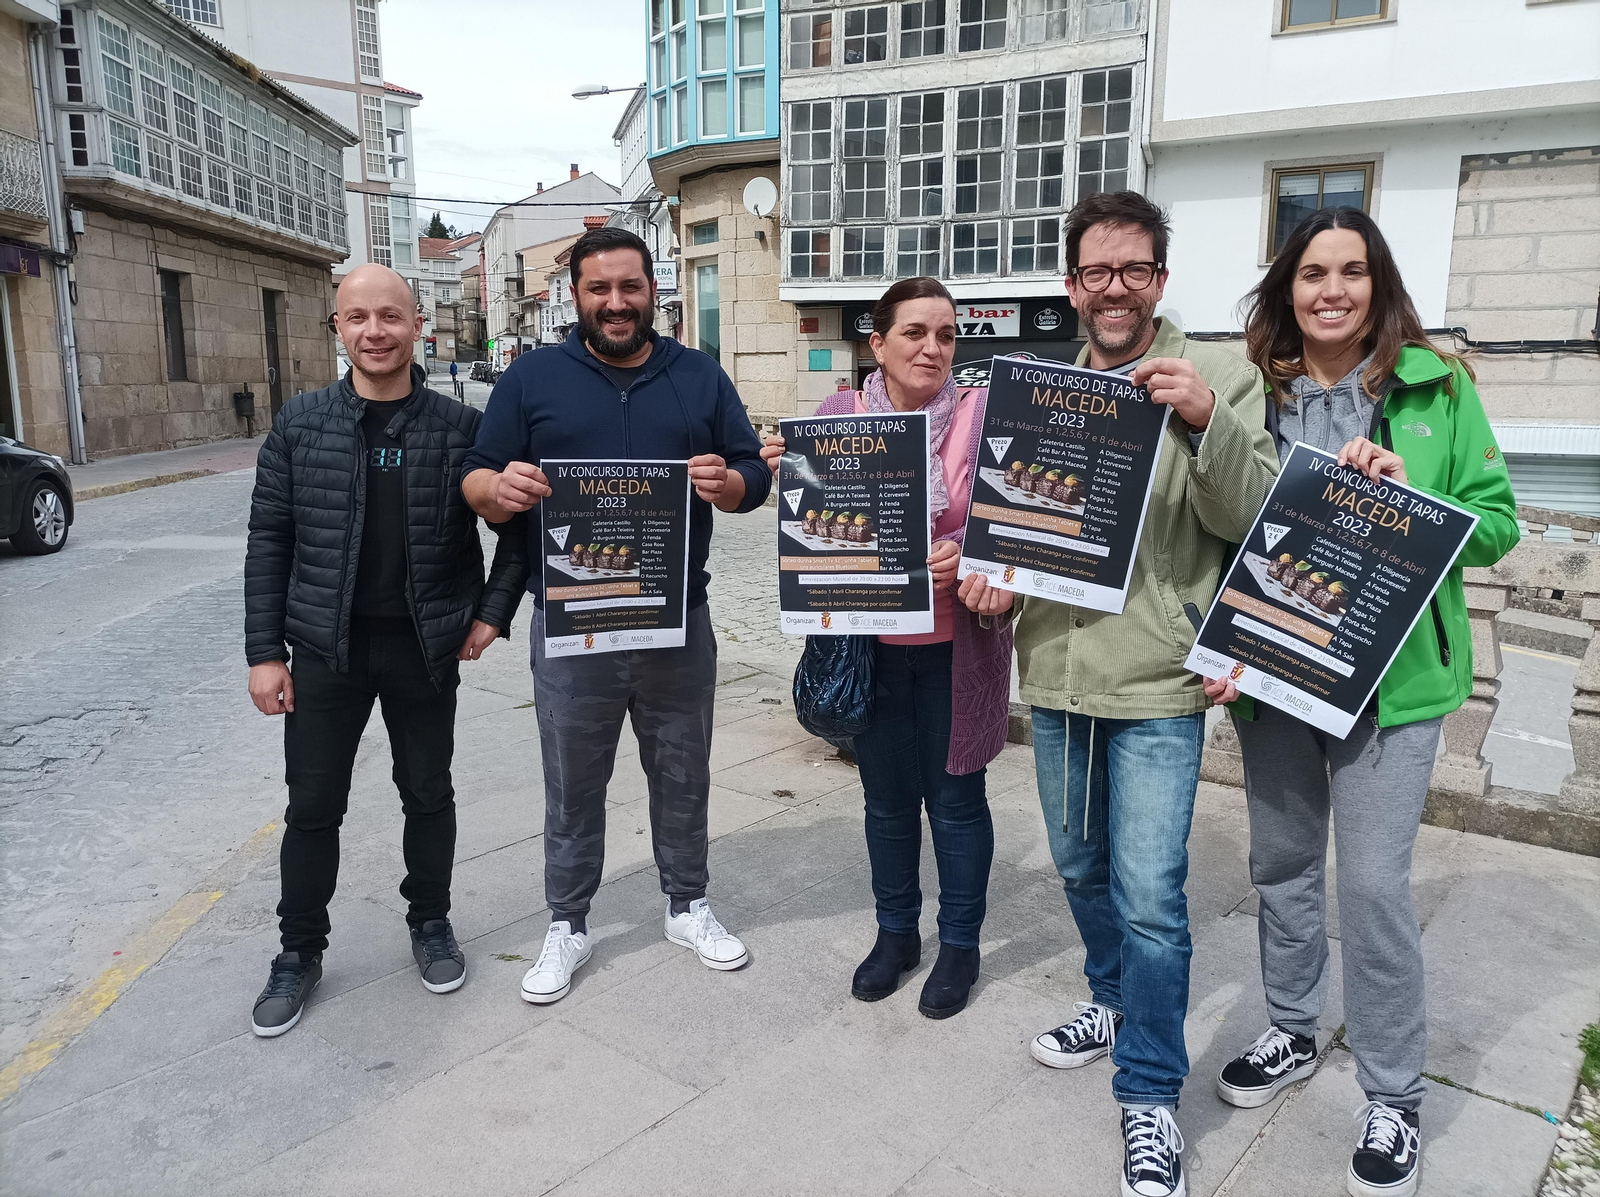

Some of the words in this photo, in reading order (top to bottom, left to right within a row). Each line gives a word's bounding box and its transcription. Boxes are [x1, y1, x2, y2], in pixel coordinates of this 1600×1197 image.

[968, 308, 1015, 318] bar
[1011, 367, 1023, 380] IV
[1025, 370, 1090, 391] CONCURSO
[1092, 379, 1108, 394] DE
[1111, 382, 1145, 402] TAPAS
[1032, 386, 1118, 420] MACEDA
[1048, 411, 1085, 428] 2023
[794, 425, 803, 437] IV
[805, 422, 856, 437] CONCURSO
[860, 421, 872, 434] DE
[874, 420, 906, 433] TAPAS
[990, 417, 1000, 426] 31
[1003, 419, 1014, 428] de
[1016, 421, 1043, 432] Marzo
[1099, 435, 1106, 444] 8
[1107, 438, 1119, 447] de
[1120, 441, 1143, 452] Abril
[815, 436, 887, 456] MACEDA
[991, 438, 1008, 446] Prezo
[830, 457, 860, 470] 2023
[1041, 456, 1063, 465] Burguer
[1064, 460, 1086, 469] Maceda
[558, 467, 568, 478] IV
[570, 466, 624, 478] CONCURSO
[626, 466, 638, 477] DE
[641, 467, 670, 478] TAPAS
[794, 471, 803, 480] de
[883, 470, 894, 479] de
[896, 470, 915, 478] Abril
[580, 479, 652, 495] MACEDA
[1308, 457, 1324, 471] IV
[1324, 463, 1389, 498] CONCURSO
[1388, 491, 1408, 508] DE
[1407, 498, 1447, 525] TAPAS
[597, 497, 626, 508] 2023
[1322, 482, 1410, 536] MACEDA
[1266, 524, 1284, 534] Prezo
[1332, 511, 1372, 537] 2023
[1272, 502, 1284, 512] 31
[1284, 507, 1297, 518] de
[1298, 513, 1325, 530] Marzo
[1379, 549, 1388, 558] 8
[1388, 554, 1402, 565] de
[1401, 560, 1426, 575] Abril
[1310, 544, 1324, 554] Café
[1324, 550, 1335, 558] Bar
[1341, 557, 1362, 571] Teixeira
[1341, 547, 1362, 560] Castillo
[1312, 555, 1335, 569] Burguer
[1334, 565, 1357, 580] Maceda
[1382, 566, 1411, 583] Diligencia
[1057, 584, 1084, 598] MACEDA
[1360, 589, 1374, 599] Casa
[1372, 595, 1390, 606] Rosa
[1371, 583, 1390, 596] Fenda
[1350, 606, 1368, 619] Pagas
[1355, 597, 1366, 606] Bar
[1366, 602, 1382, 614] Plaza
[1344, 616, 1360, 627] Porta
[1360, 624, 1376, 635] Sacra
[1337, 638, 1352, 649] Tapa
[1344, 628, 1372, 646] Recuncho
[1325, 643, 1337, 652] Bar
[1342, 652, 1355, 661] Sala
[1260, 644, 1275, 653] Abril
[1274, 650, 1300, 665] Charanga
[1299, 662, 1311, 670] por
[1310, 668, 1338, 683] confirmar
[1254, 656, 1268, 666] Abril
[1267, 662, 1293, 678] Charanga
[1292, 674, 1304, 683] por
[1303, 680, 1330, 696] confirmar
[1284, 693, 1313, 713] MACEDA
